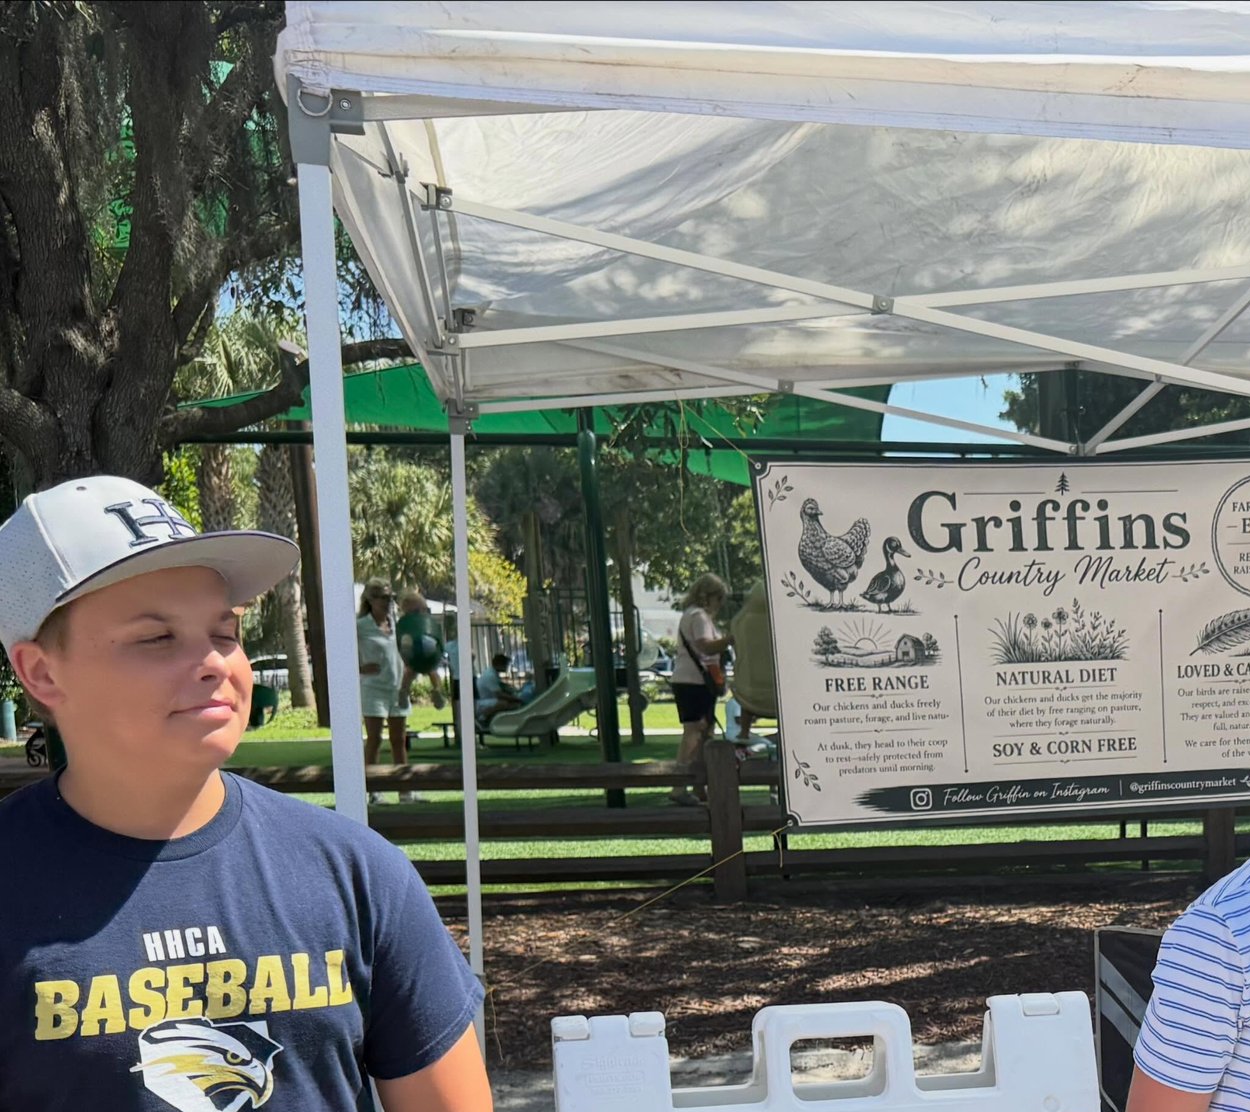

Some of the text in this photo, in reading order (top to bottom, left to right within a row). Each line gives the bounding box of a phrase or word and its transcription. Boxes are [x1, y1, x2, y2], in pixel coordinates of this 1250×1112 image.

[907, 491, 1191, 553] Griffins
[958, 555, 1176, 596] Country Market
[996, 668, 1117, 686] NATURAL DIET
[1177, 664, 1220, 678] LOVED
[1224, 664, 1233, 676] &
[825, 675, 929, 692] FREE RANGE
[985, 696, 1000, 705] Our
[1003, 695, 1036, 704] chickens
[1082, 694, 1093, 702] get
[1096, 692, 1108, 700] the
[1111, 691, 1142, 701] majority
[1177, 688, 1193, 697] Our
[1196, 688, 1216, 696] birds
[813, 699, 941, 712] Our chickens and ducks freely
[998, 708, 1016, 716] their
[1019, 707, 1034, 716] diet
[1036, 707, 1046, 716] by
[1049, 706, 1064, 714] free
[1066, 705, 1096, 715] ranging
[1111, 704, 1142, 714] pasture,
[1192, 701, 1220, 710] respect,
[1222, 699, 1236, 707] and
[830, 716, 863, 726] pasture,
[866, 714, 894, 723] forage,
[896, 713, 910, 721] and
[928, 712, 949, 720] natu-
[1010, 716, 1116, 728] where they forage naturally.
[1180, 712, 1199, 722] They
[1215, 711, 1239, 719] valued
[1213, 722, 1227, 731] full,
[817, 742, 827, 751] At
[830, 740, 852, 751] dusk,
[855, 740, 872, 751] they
[875, 739, 894, 749] head
[908, 738, 925, 746] their
[928, 739, 948, 747] coop
[993, 737, 1137, 758] SOY & CORN FREE
[1185, 740, 1197, 748] We
[1220, 738, 1231, 746] for
[883, 750, 922, 760] protected
[923, 750, 943, 759] from
[1222, 750, 1230, 758] of
[1232, 749, 1245, 757] the
[839, 763, 935, 777] predators until morning.
[1129, 776, 1236, 793] @griffinscountrymarket
[942, 782, 1110, 806] Follow Griffin on Instagram
[142, 925, 226, 962] HHCA
[34, 949, 354, 1042] BASEBALL
